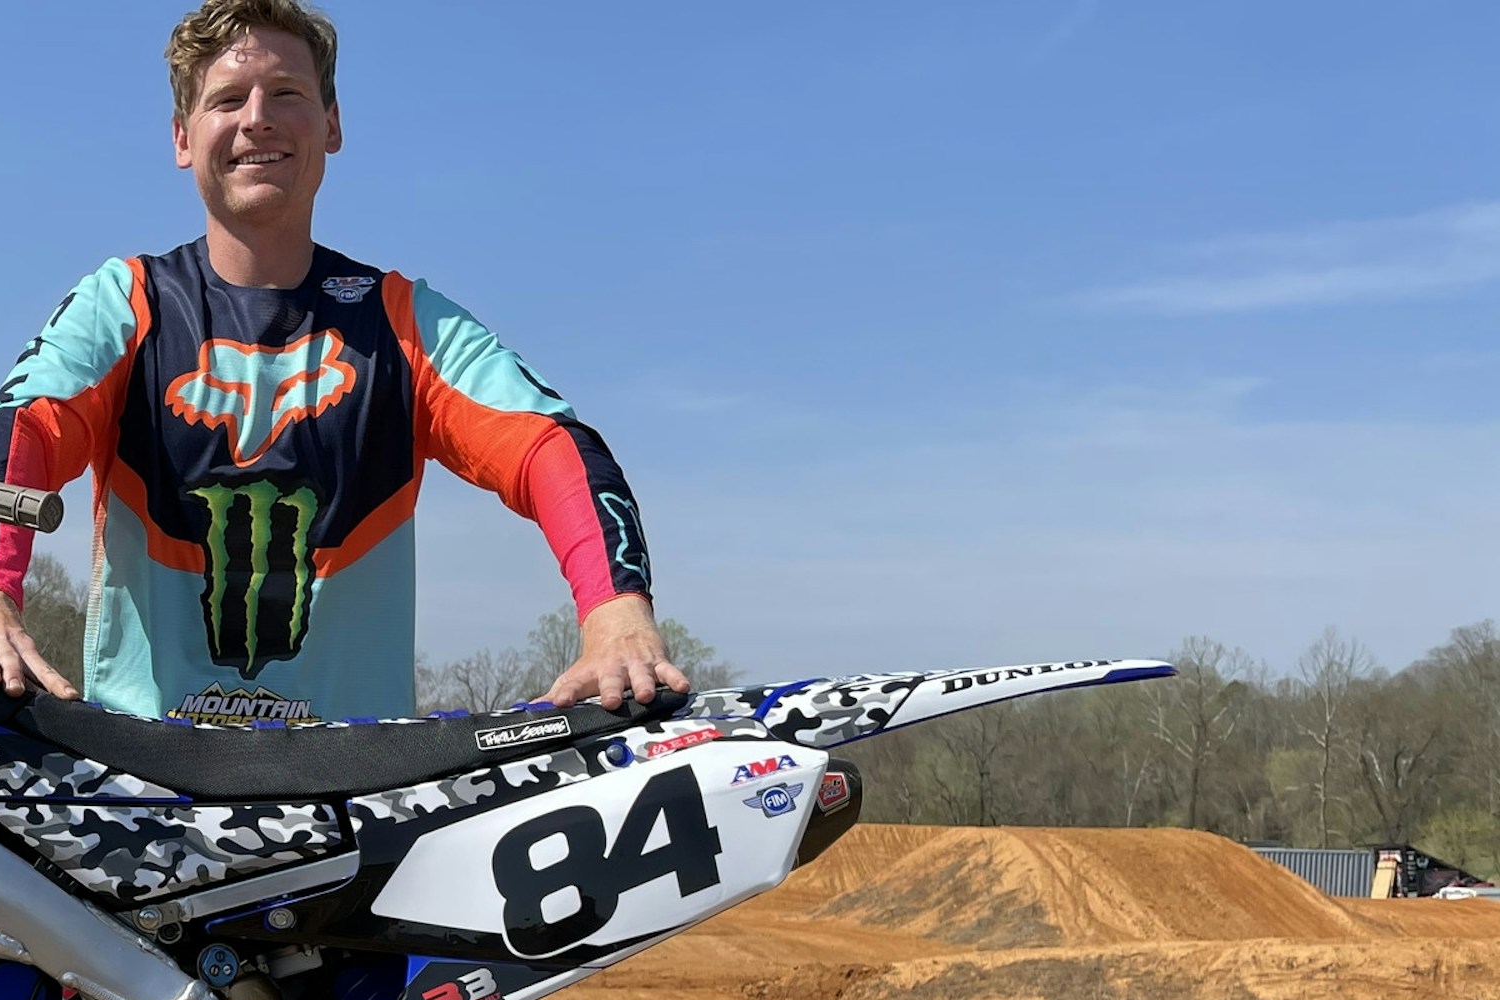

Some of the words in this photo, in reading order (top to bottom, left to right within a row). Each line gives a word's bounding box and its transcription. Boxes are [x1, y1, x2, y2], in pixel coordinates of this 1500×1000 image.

[180, 694, 312, 719] MOUNTAIN
[731, 755, 798, 784] AMA
[765, 792, 788, 808] FIM
[492, 764, 723, 959] 84
